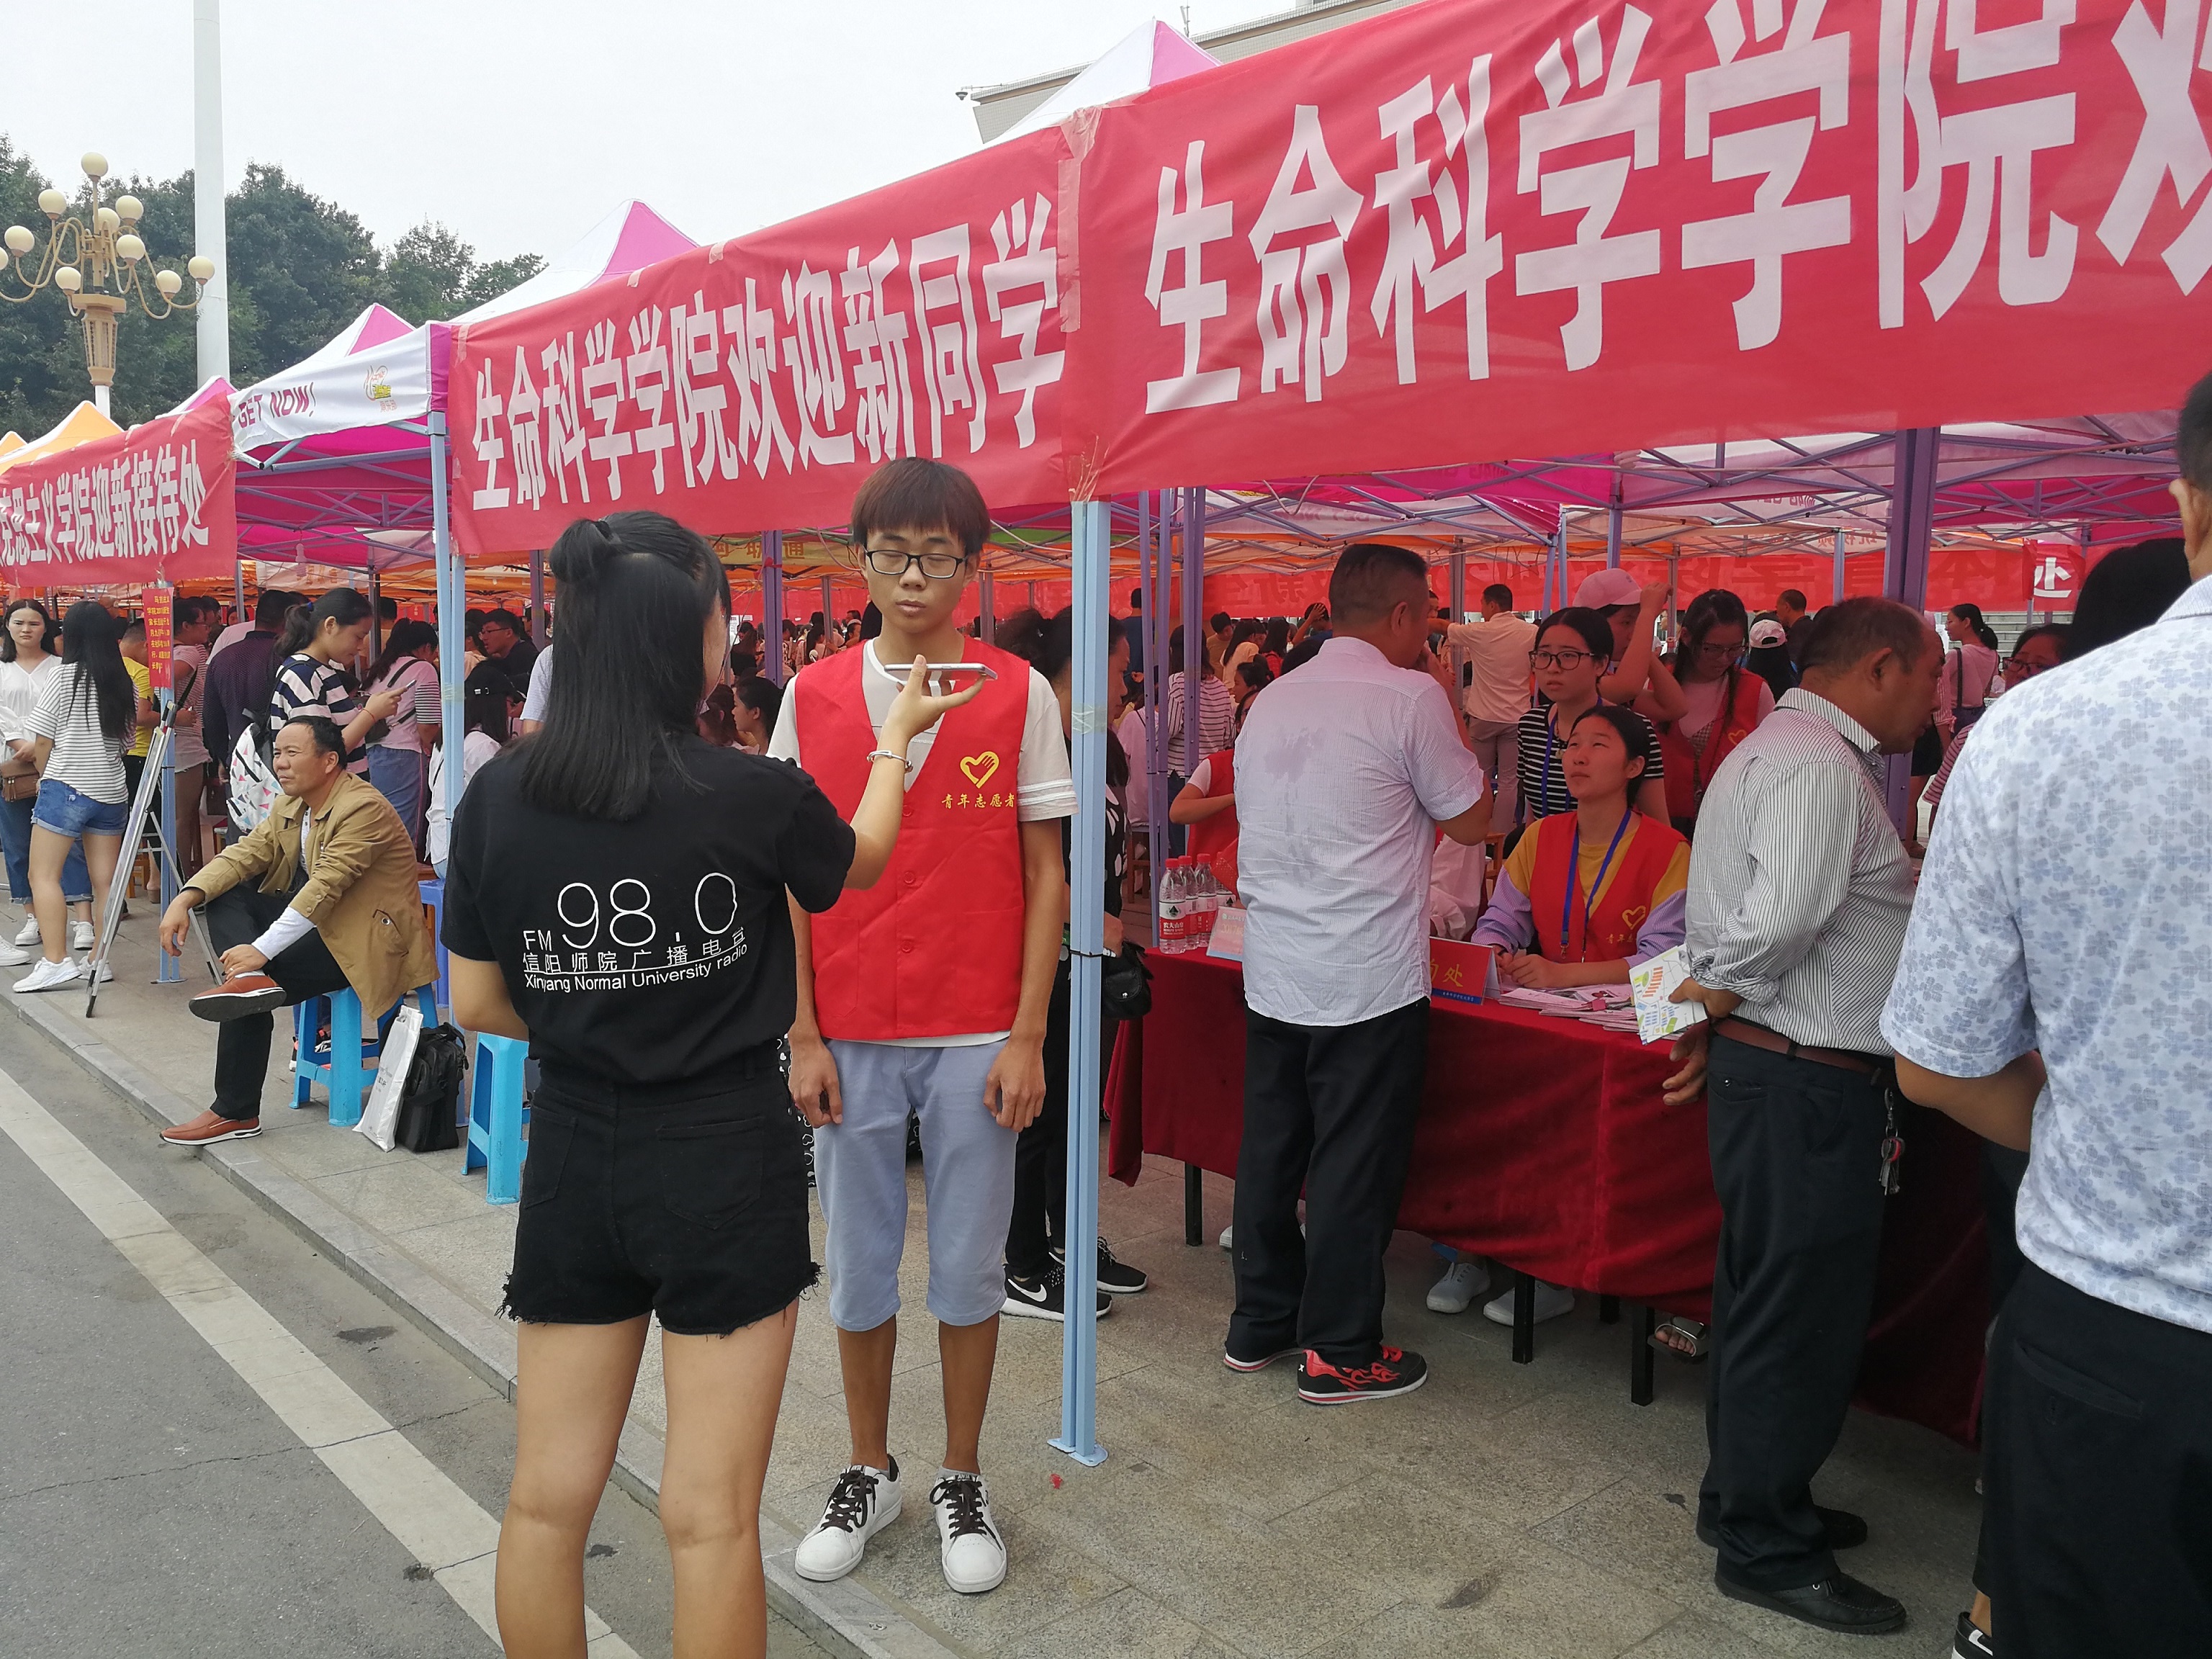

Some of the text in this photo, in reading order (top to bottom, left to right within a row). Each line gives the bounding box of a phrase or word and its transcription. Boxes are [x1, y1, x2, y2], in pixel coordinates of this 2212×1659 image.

[472, 192, 1064, 510] 生命科学学院欢迎新同学
[238, 382, 315, 428] GET NOW!
[942, 793, 1015, 809] 青年志愿者
[523, 873, 737, 951] FM 98.0
[523, 927, 746, 973] 信阳师院广播电台
[526, 943, 747, 993] Xinyang Normal University radio
